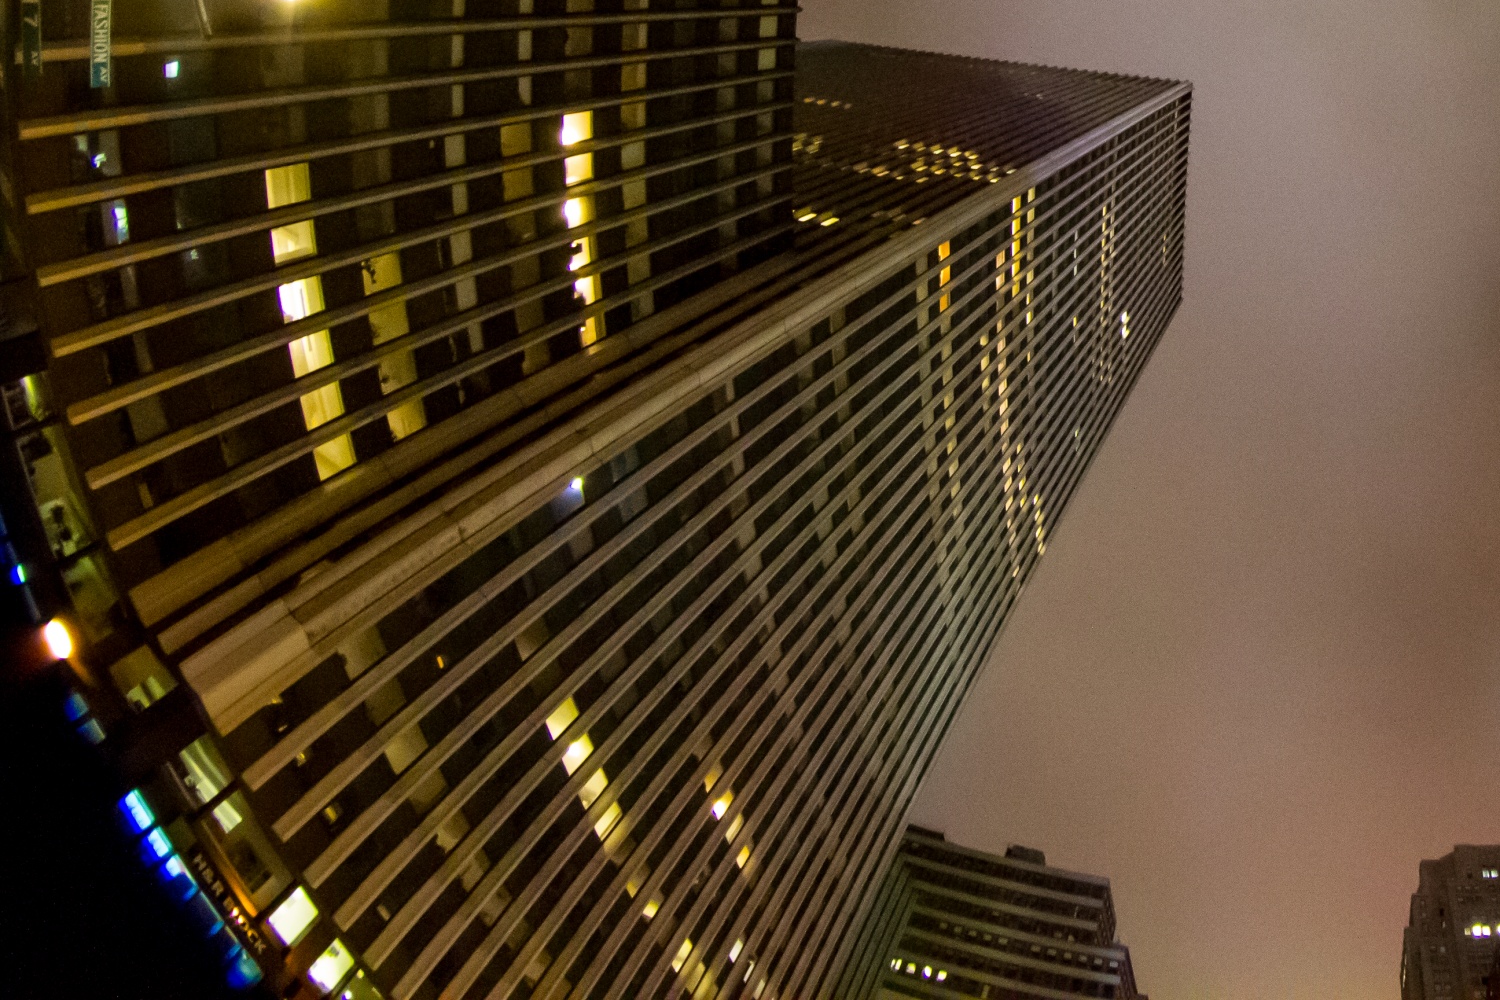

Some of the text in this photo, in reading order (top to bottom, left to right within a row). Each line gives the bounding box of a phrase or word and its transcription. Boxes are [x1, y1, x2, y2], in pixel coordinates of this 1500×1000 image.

[23, 14, 37, 27] 7
[93, 4, 107, 82] FASHION AV
